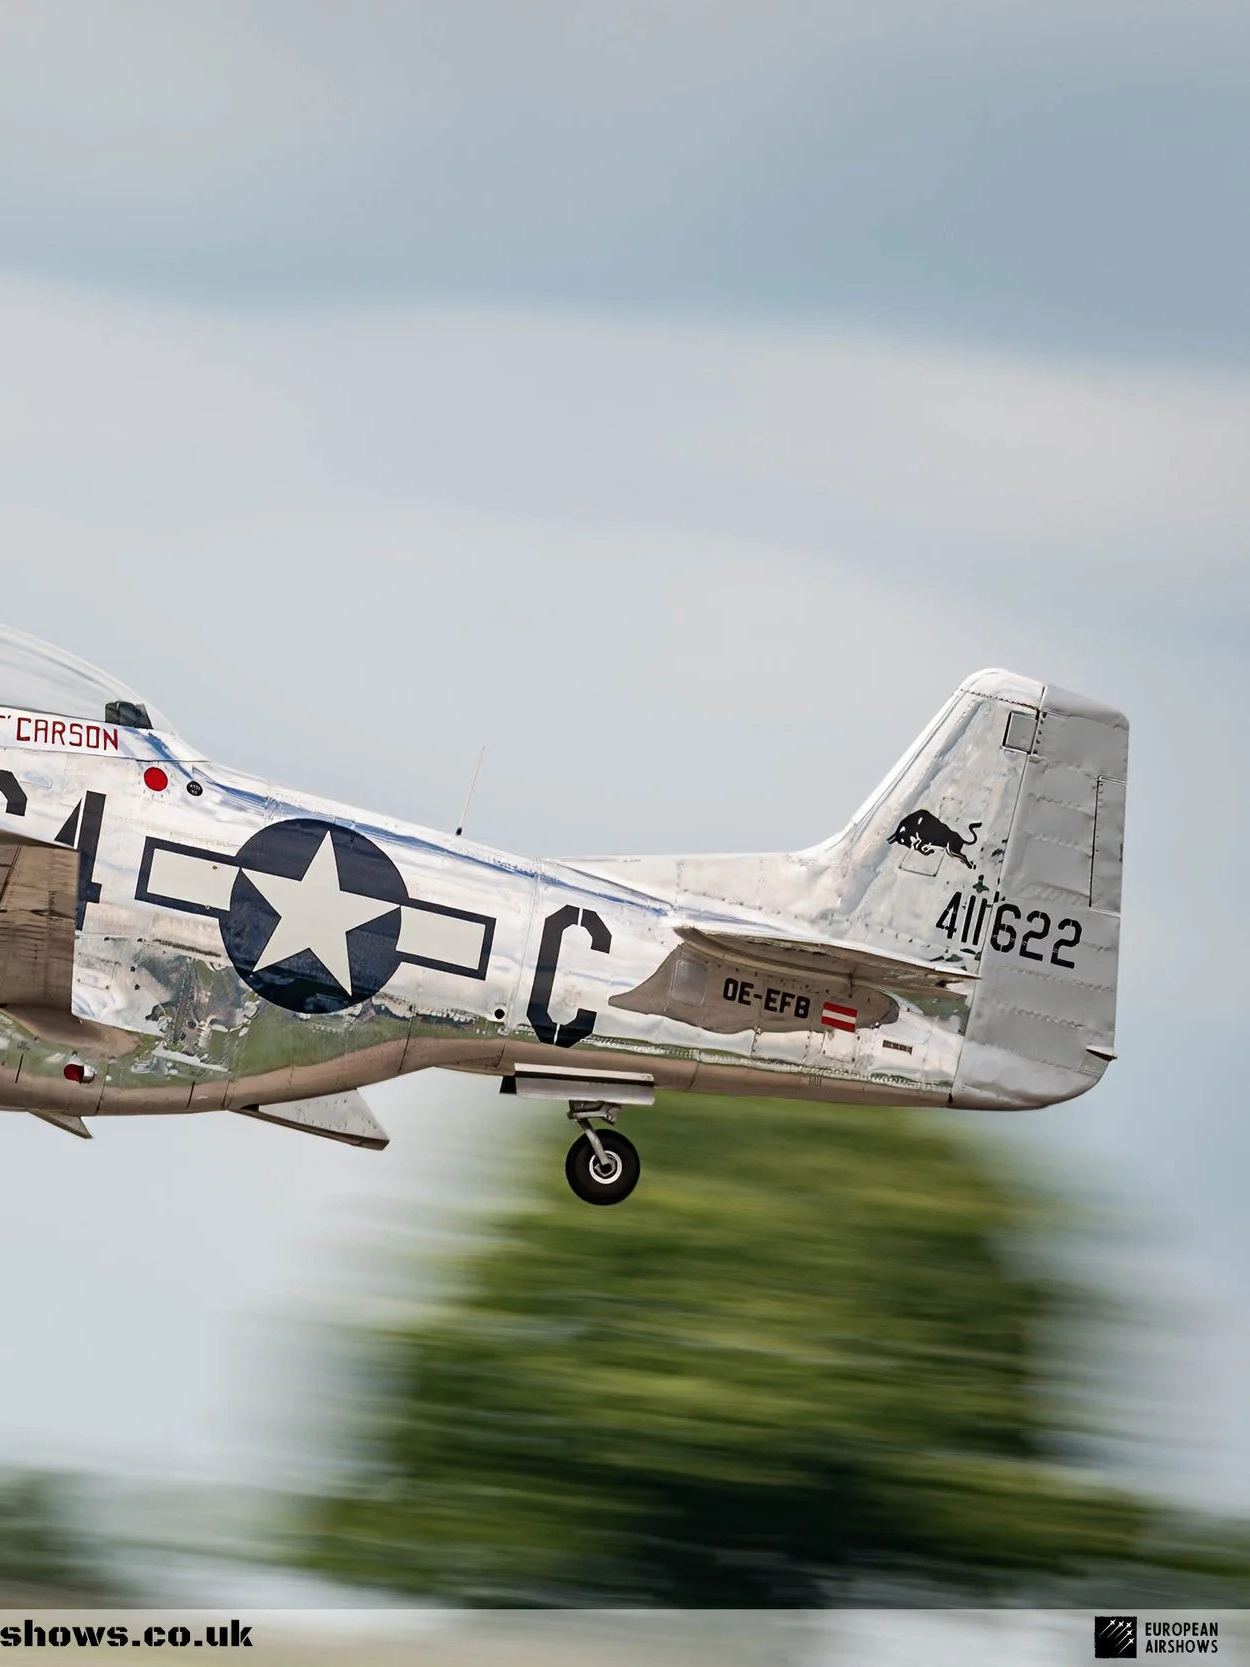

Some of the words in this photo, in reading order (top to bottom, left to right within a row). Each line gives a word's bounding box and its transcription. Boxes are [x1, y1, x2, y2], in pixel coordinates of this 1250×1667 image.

[16, 717, 118, 750] CARSON
[935, 891, 1082, 969] 411622
[526, 904, 612, 1048] C
[722, 977, 811, 1019] OE-EFB
